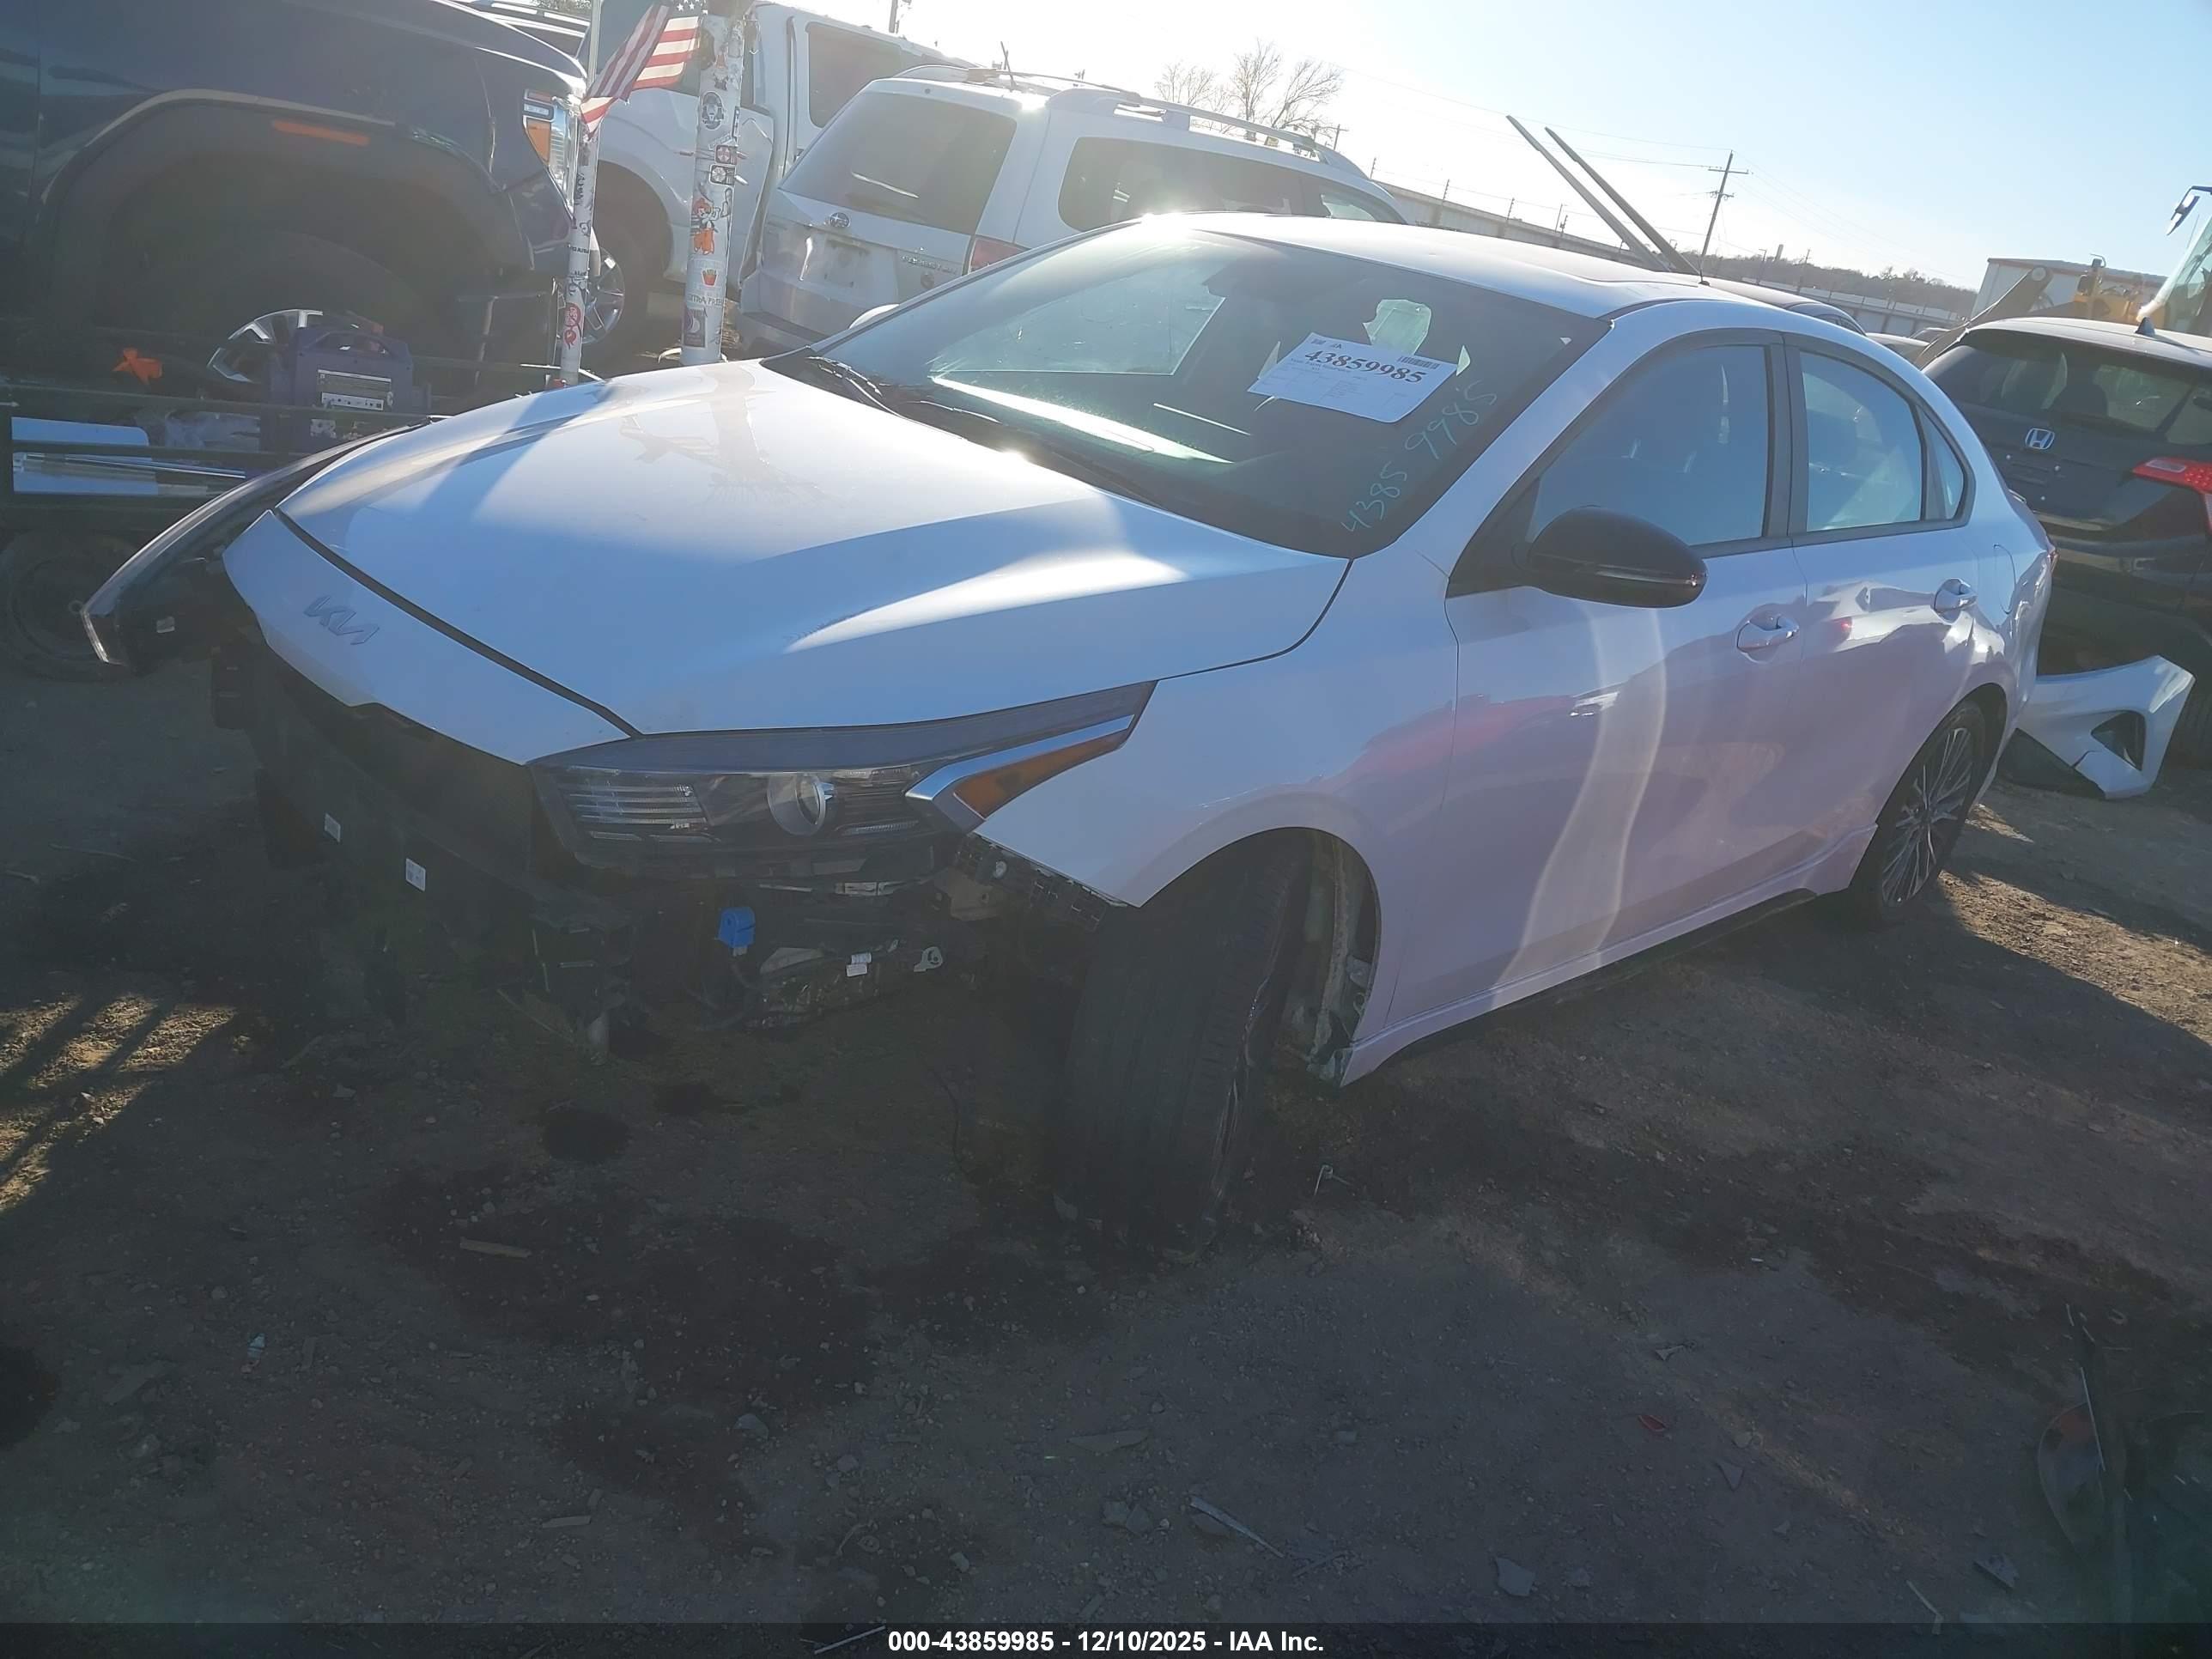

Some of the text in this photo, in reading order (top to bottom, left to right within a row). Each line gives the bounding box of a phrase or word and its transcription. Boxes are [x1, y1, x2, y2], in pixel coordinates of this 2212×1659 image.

[1304, 350, 1428, 383] 43859985
[1340, 380, 1498, 532] 4385 9985
